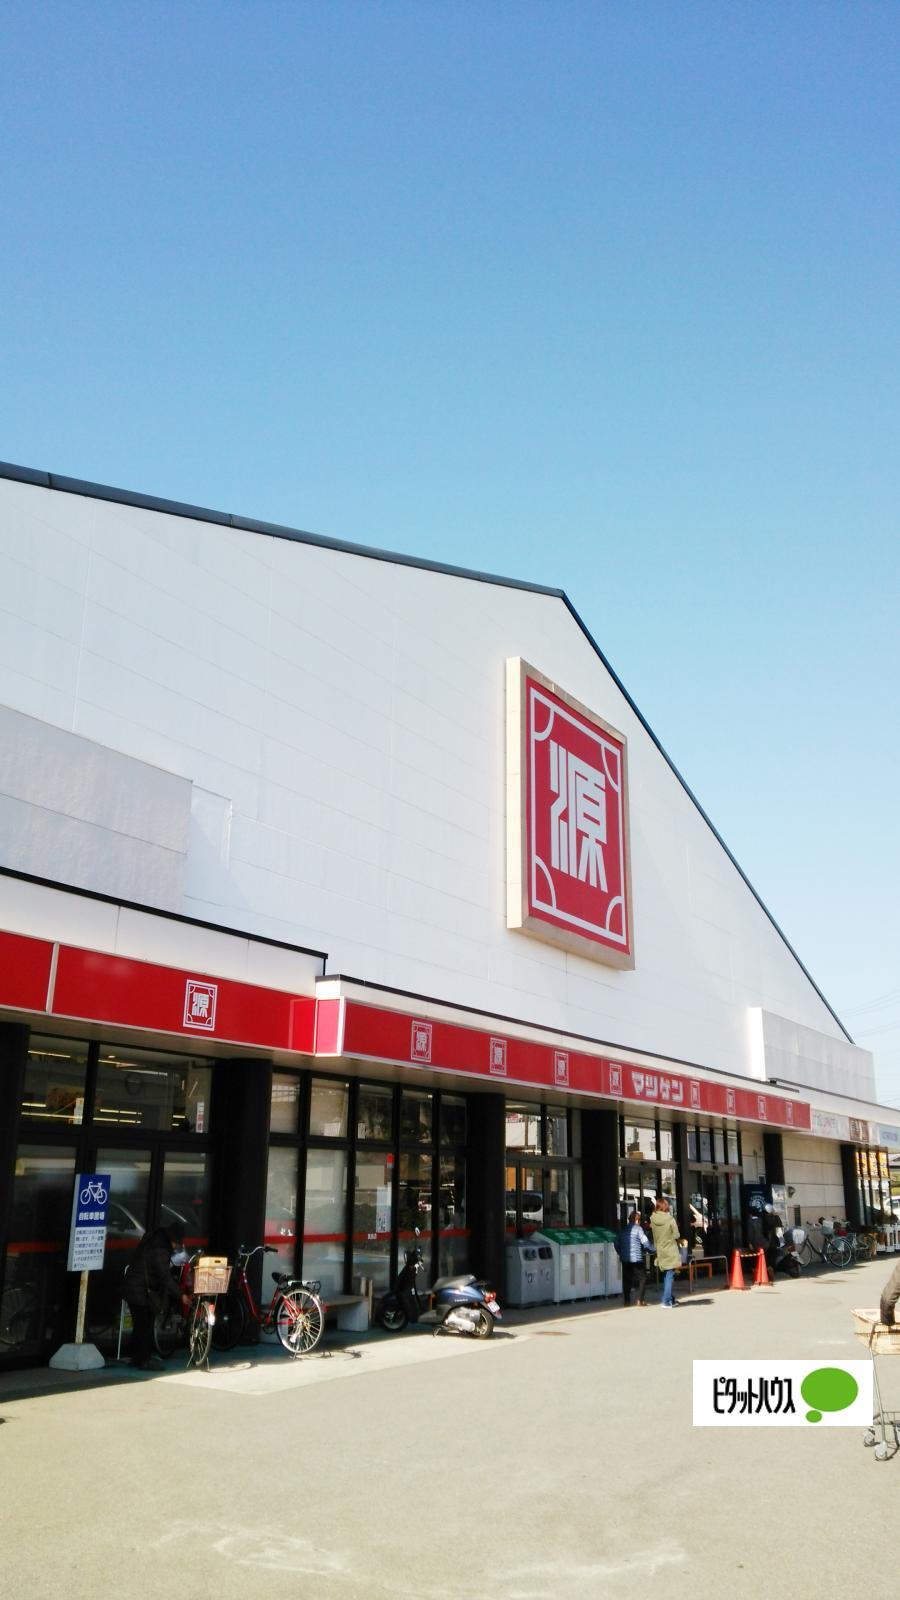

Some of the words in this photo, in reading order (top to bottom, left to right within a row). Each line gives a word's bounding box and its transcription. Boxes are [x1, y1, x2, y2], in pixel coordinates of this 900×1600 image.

[549, 739, 609, 893] 源
[191, 991, 210, 1018] 源
[631, 1071, 684, 1103] マツケン
